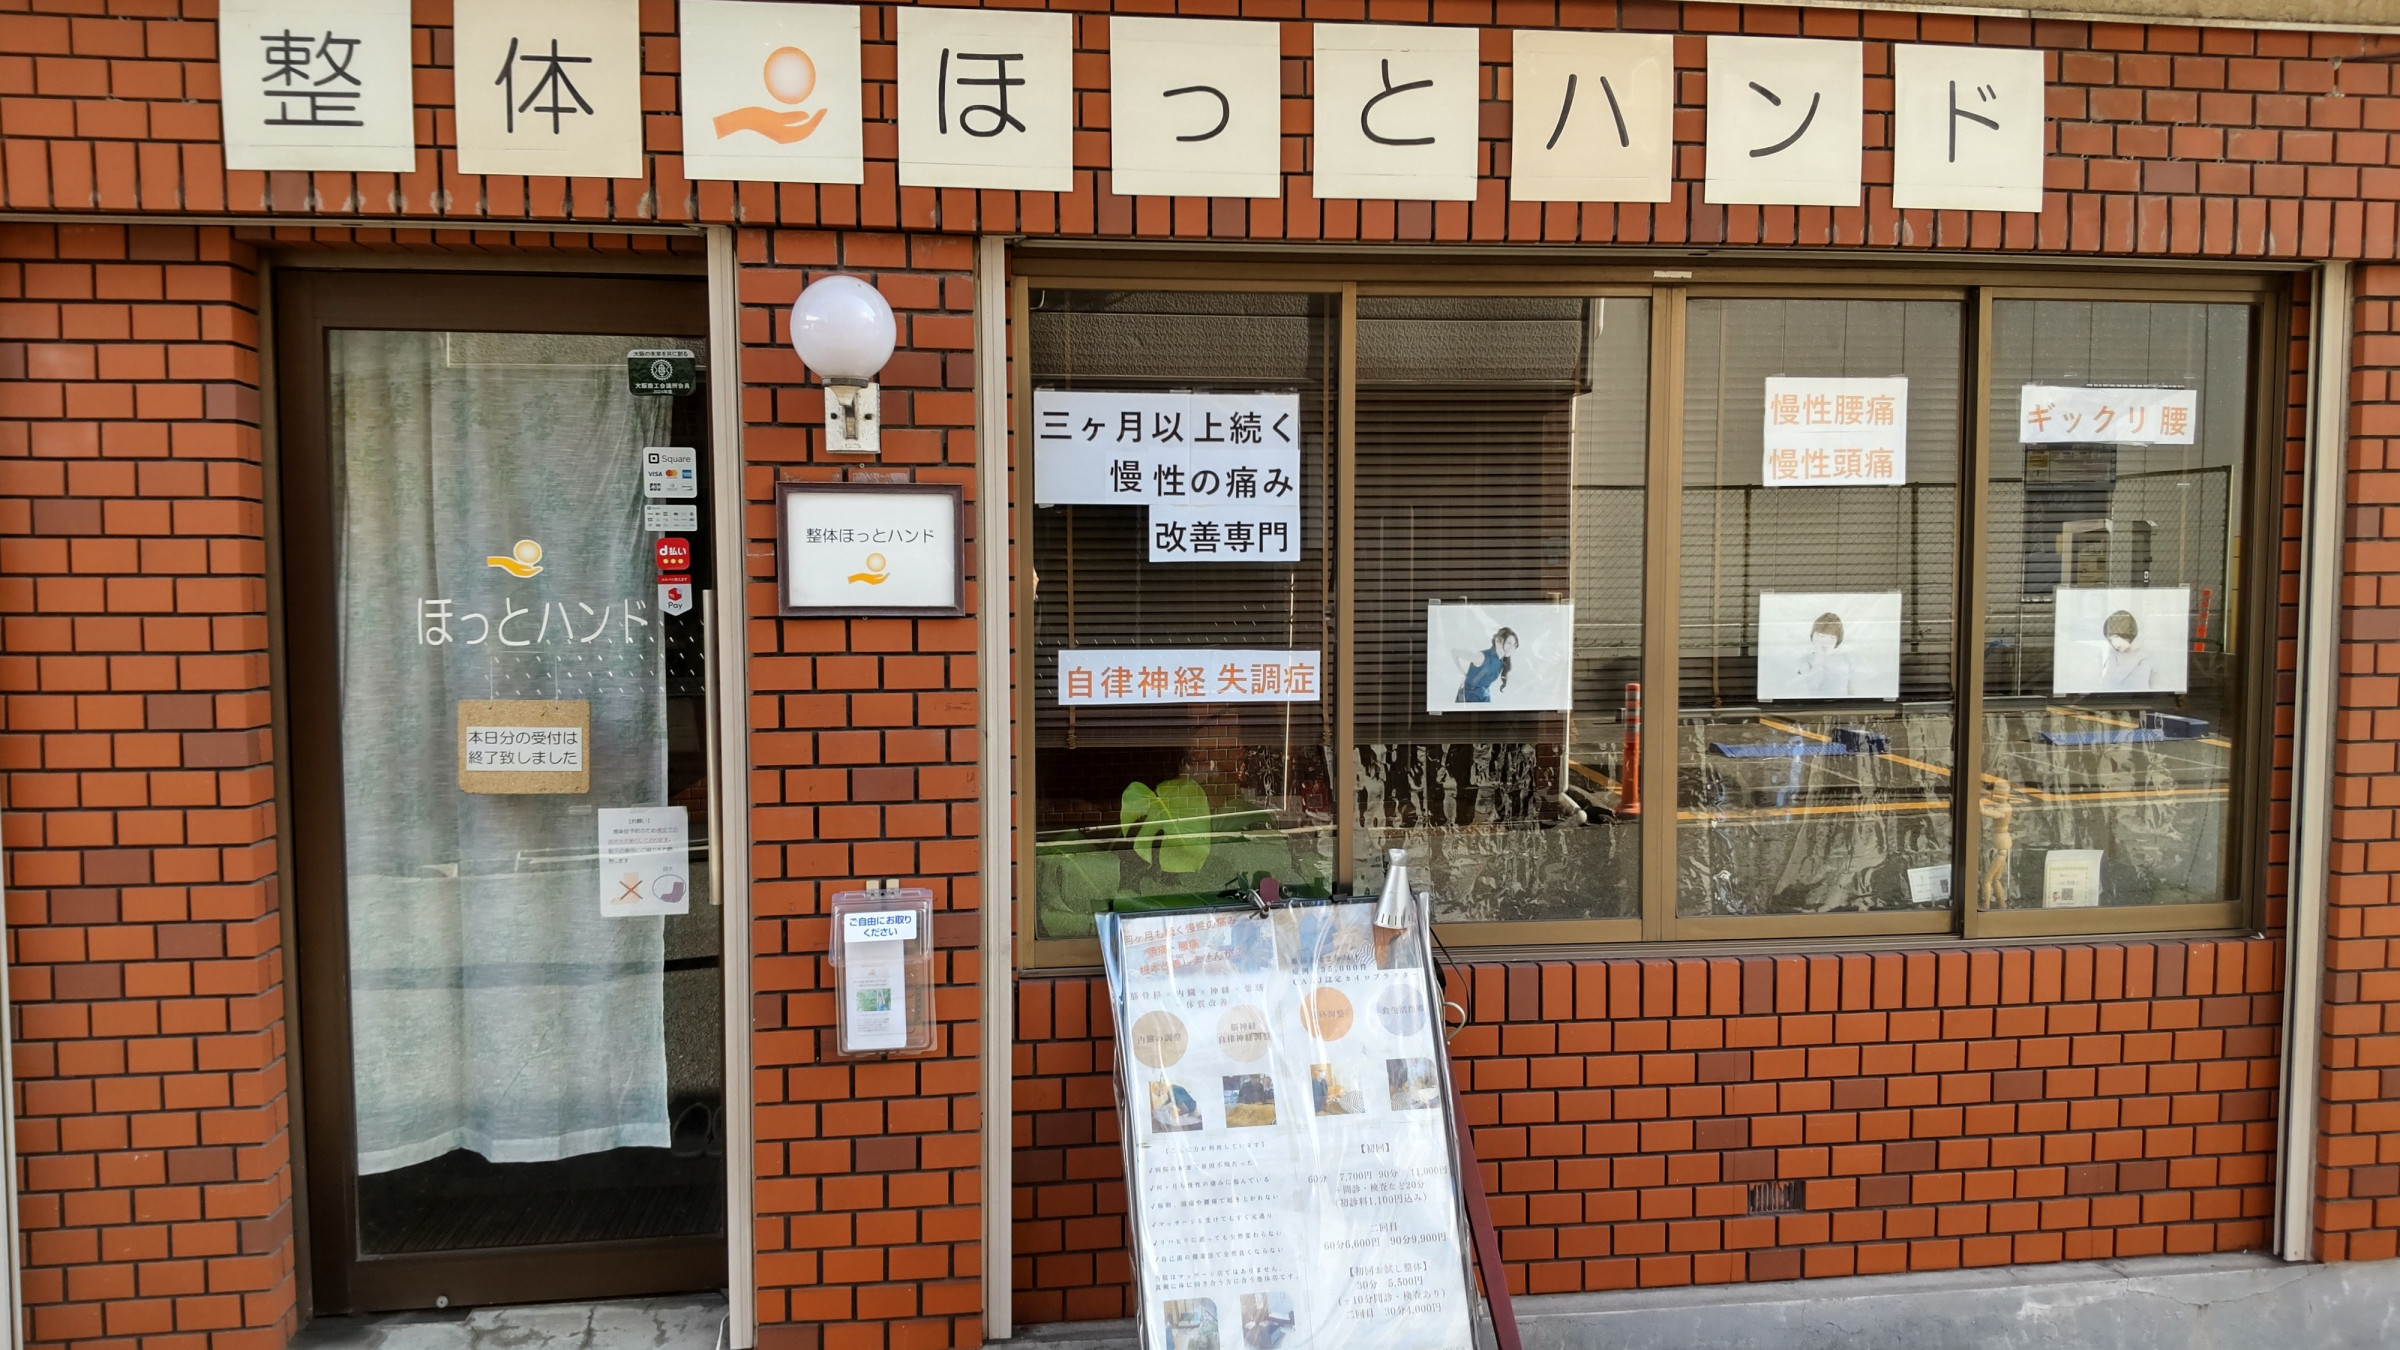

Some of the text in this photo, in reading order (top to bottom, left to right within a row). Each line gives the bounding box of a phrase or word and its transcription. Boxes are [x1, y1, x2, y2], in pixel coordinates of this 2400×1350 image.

[259, 28, 2000, 162] 整体 ほっとハンド
[1770, 394, 1896, 427] 慢性腰痛
[1040, 410, 1292, 445] 三ヶ月以上続く
[2026, 402, 2189, 437] ギックリ腰
[661, 454, 692, 464] Square
[1768, 446, 1895, 481] 慢性頭痛
[1109, 459, 1294, 499] 慢性の痛み
[805, 527, 935, 544] 整体ほっとハンド
[1155, 521, 1289, 553] 改善専門
[659, 544, 687, 556] d払い
[668, 601, 683, 610] Pay
[416, 596, 649, 647] ほっとハンド
[1067, 662, 1316, 699] 自律神経失調症
[467, 730, 579, 746] 本日分の受付は
[467, 749, 578, 766] 終了致しました
[849, 915, 912, 927] ご自由にお取り
[863, 927, 898, 938] ください
[1339, 1170, 1373, 1182] 7,700円
[1378, 1168, 1399, 1179] 90分
[1356, 1275, 1423, 1290] 30分 5,500円
